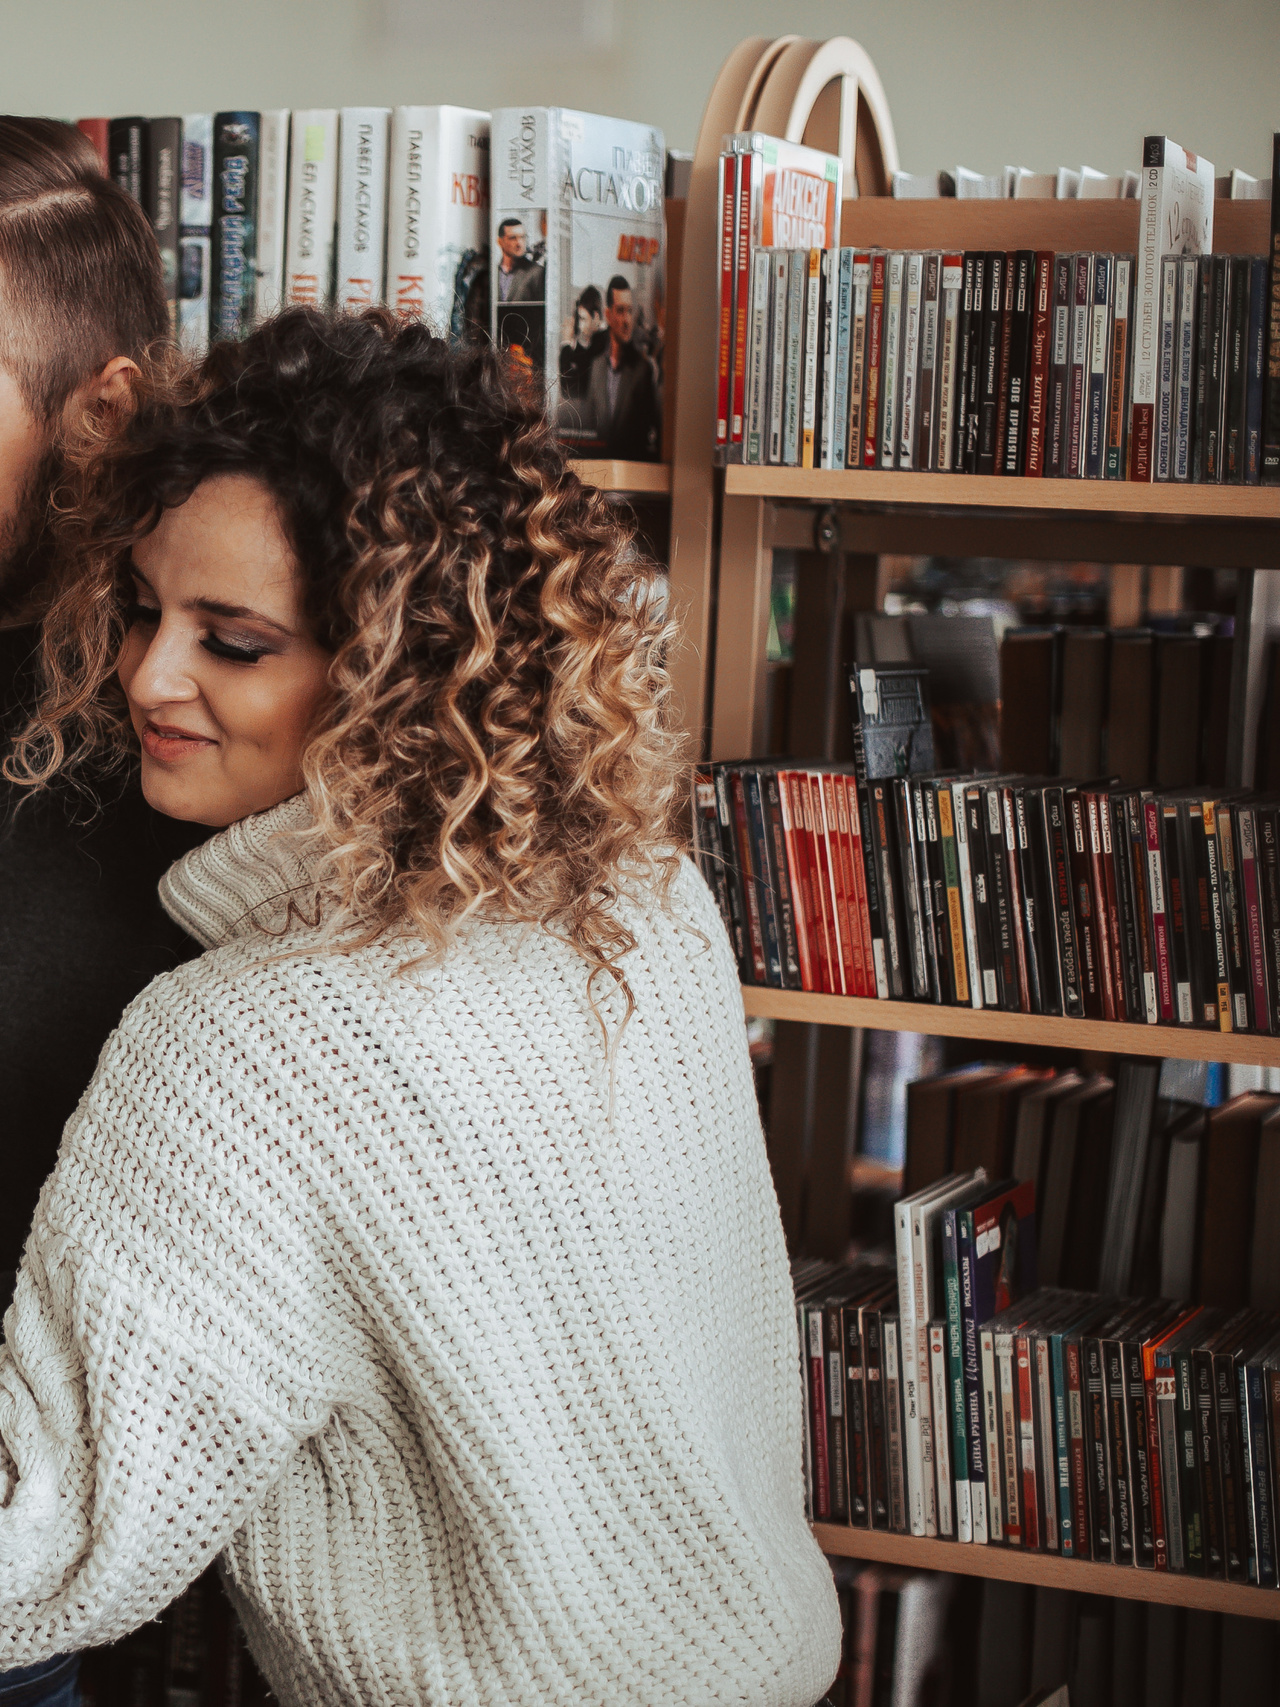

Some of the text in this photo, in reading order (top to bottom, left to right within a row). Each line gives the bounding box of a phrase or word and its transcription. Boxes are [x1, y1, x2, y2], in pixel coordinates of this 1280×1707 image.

[508, 136, 519, 180] ПАВЕЛ
[520, 115, 536, 202] АСТАХОВ
[1150, 144, 1159, 163] Mp3
[355, 124, 373, 253] ПАВЕЛ АСТАХОВ
[562, 167, 663, 213] АСТАХОВ
[1150, 169, 1158, 180] CD
[405, 130, 422, 259] ПАВЕЛ АСТАХОВ
[299, 188, 316, 259] АСТАХОВ
[1144, 195, 1156, 296] ЗОЛОТОЙ ТЕЛЁНОК
[875, 263, 883, 284] mp3
[891, 265, 899, 285] mp3
[909, 265, 918, 285] mp3
[928, 262, 936, 292] АРДИС
[1040, 260, 1048, 288] АУДИО
[1059, 266, 1067, 295] АРДИС
[927, 308, 935, 346] ЗАМЯТИН
[1035, 315, 1046, 365] А. Зорич
[1141, 302, 1152, 360] 12 СТУЛЬЕВ
[1163, 331, 1171, 350] ИЛЬФ,
[1162, 358, 1170, 382] ПЕТРОВ
[1006, 378, 1021, 470] ЗОВ ПРИПЯТИ
[1054, 383, 1062, 440] ИМПЕРАТРИЦА
[1140, 408, 1149, 440] the best
[1071, 425, 1079, 444] ЦАРЯ
[1160, 392, 1170, 474] ЗОЛОТОЙ ТЕЛЕНОК
[1178, 387, 1188, 474] ДВЕНАДЦАТЬ СТУЛЬЕВ
[1109, 459, 1116, 468] CD
[1138, 442, 1147, 476] АРДИС
[1051, 806, 1061, 826] mp3
[1073, 801, 1081, 830] АУДИО
[1100, 802, 1109, 831] АУДИО
[1243, 818, 1251, 847] АРДИС
[1264, 822, 1273, 844] mp3
[1152, 854, 1161, 910] www.ardisbook.ru
[999, 899, 1009, 949] МЛЕЧИН
[1208, 840, 1225, 977] ВЛАДИМИР ОБРУЧЕВ ПЛУТОНИЯ
[1060, 911, 1076, 983] время героев
[1251, 905, 1263, 987] ОДЕССКИЙ ЮМОР
[1158, 926, 1170, 1005] НОВЫЙ САТИРИКОН
[1181, 992, 1190, 1021] Акелла
[1070, 1351, 1079, 1379] АРДИС
[1089, 1352, 1099, 1373] mp3
[1111, 1358, 1120, 1378] mp3
[1131, 1357, 1139, 1378] mp3
[1200, 1368, 1209, 1389] mp3
[953, 1378, 963, 1412] РУБИНА
[1219, 1373, 1227, 1393] mp3
[1253, 1378, 1262, 1398] mp3
[968, 1391, 980, 1436] РУБИНА
[1113, 1400, 1121, 1438] Анатолий
[1136, 1410, 1145, 1446] Рыбаков
[1202, 1411, 1210, 1433] Павел
[971, 1438, 983, 1472] ДИНА
[1115, 1440, 1124, 1475] Рыбаков
[1222, 1416, 1231, 1474] Павел Санаев
[1060, 1457, 1069, 1488] КОРТИК
[1075, 1448, 1084, 1506] БРОНЗОВАЯ
[1097, 1463, 1105, 1491] АРБАТА
[1140, 1474, 1150, 1506] АРБАТА
[1258, 1470, 1270, 1555] ВРЕМЯ НАСТУПАЕТ
